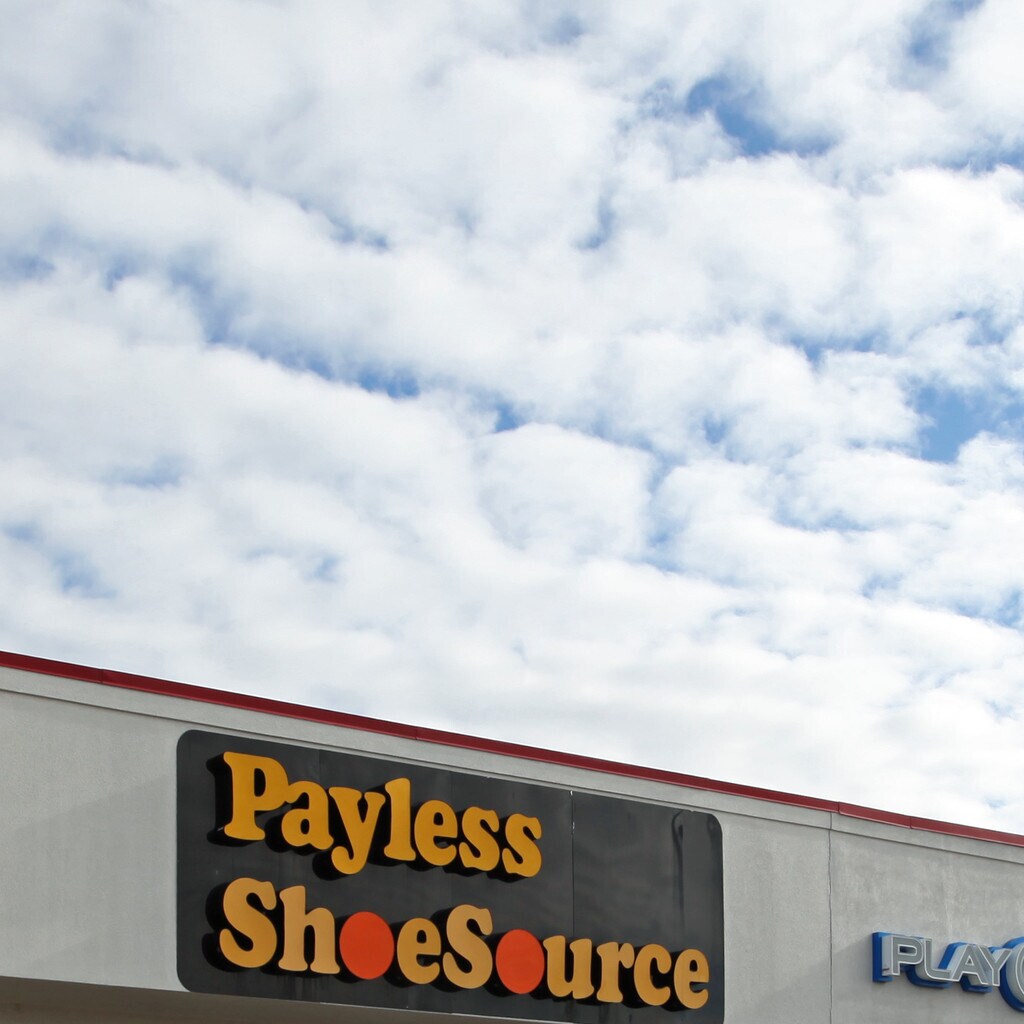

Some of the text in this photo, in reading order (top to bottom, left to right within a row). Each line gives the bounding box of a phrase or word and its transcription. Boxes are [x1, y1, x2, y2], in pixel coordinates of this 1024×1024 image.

[223, 752, 542, 878] Payless
[219, 878, 710, 1009] ShoeSource
[873, 932, 1024, 1012] PLAY
